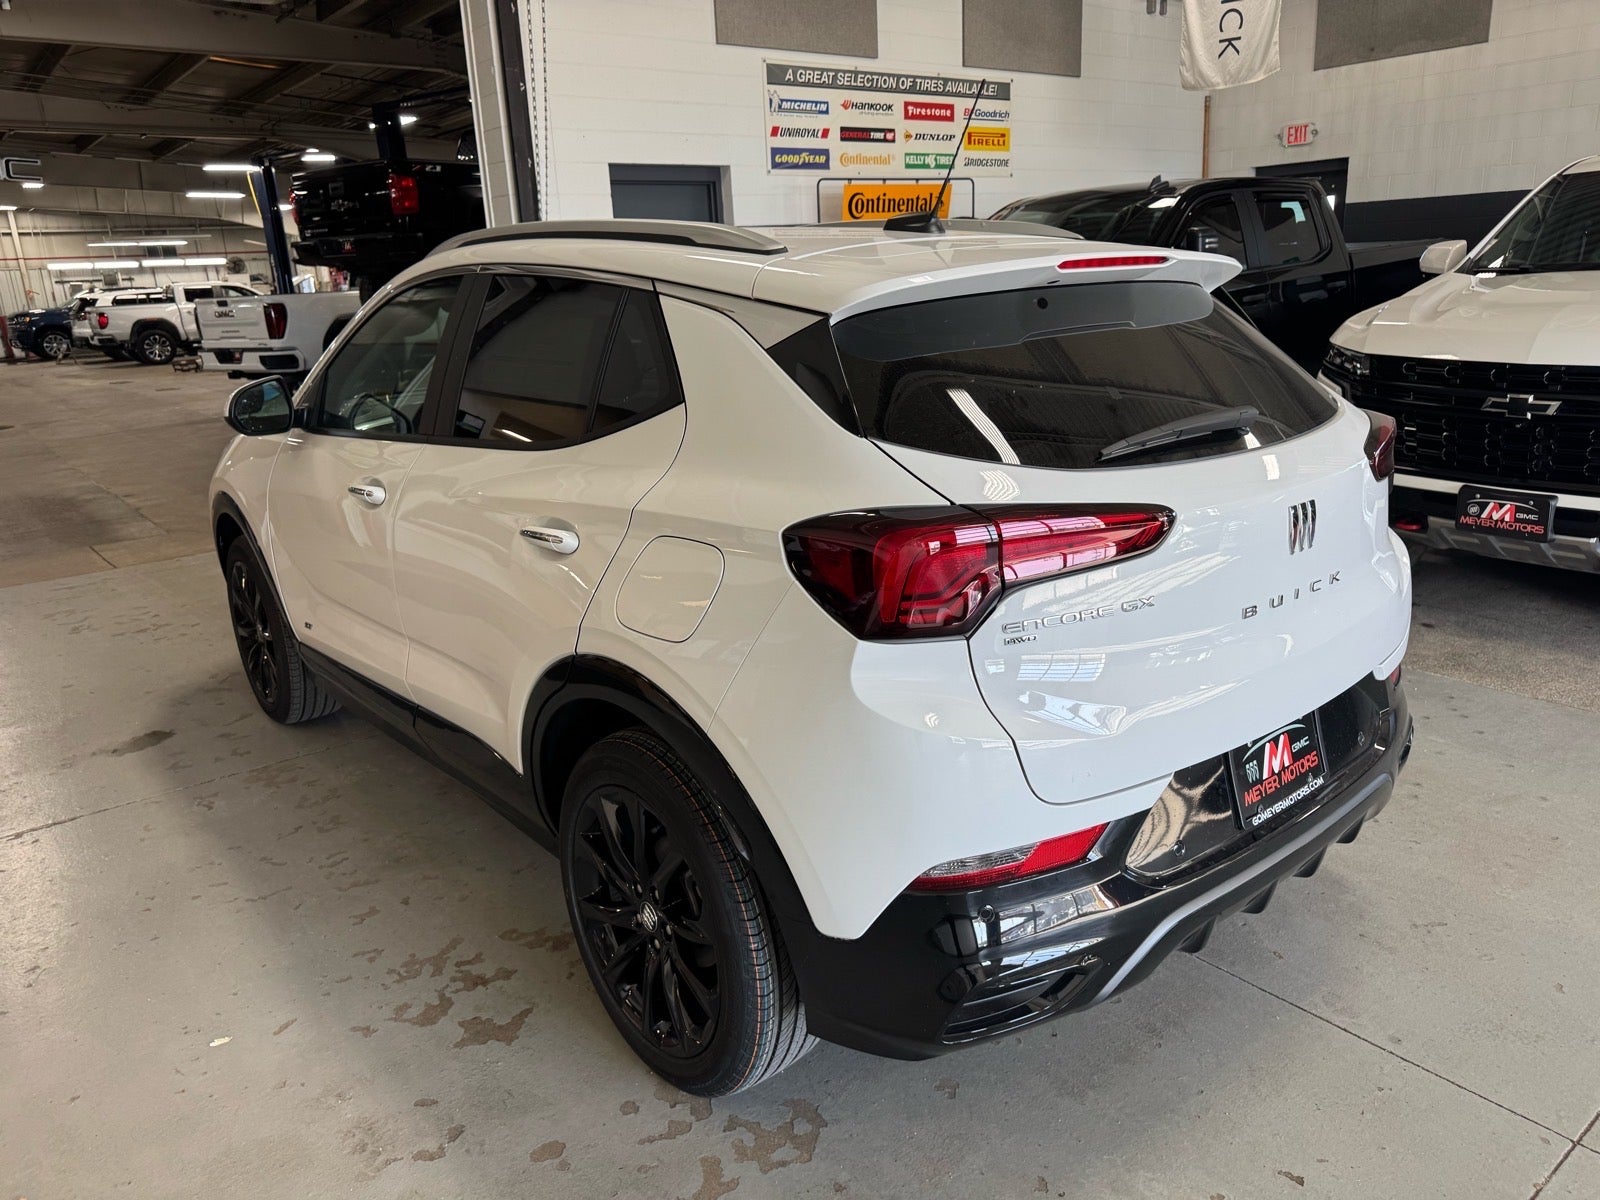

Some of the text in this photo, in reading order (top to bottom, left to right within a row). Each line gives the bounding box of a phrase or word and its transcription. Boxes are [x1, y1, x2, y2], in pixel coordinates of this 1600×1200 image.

[785, 68, 998, 96] A GREAT SELECTION OF TIRES AVAILALE!
[781, 100, 828, 112] MICHELIN
[907, 105, 952, 117] Firestone
[963, 107, 1010, 119] BGoodrich
[780, 127, 820, 139] UNIROYAL
[914, 133, 956, 141] DUNLOP
[967, 131, 1006, 146] PIRELLI
[1287, 124, 1309, 144] EXIT
[775, 152, 827, 165] GOODYEAR
[840, 152, 891, 167] Continental
[905, 155, 925, 165] KELLY
[963, 156, 1010, 168] BRIDGESTONE
[847, 191, 933, 220] Continental
[1515, 512, 1539, 521] GMC
[1460, 515, 1545, 534] MEYER MOTORS
[1241, 570, 1341, 620] BUICK
[1001, 595, 1156, 635] ENCORE GX
[1291, 736, 1310, 753] GMC
[1244, 750, 1319, 807] MEYER MOTORS
[1252, 776, 1325, 826] GOMEYERMOTORS.COM
